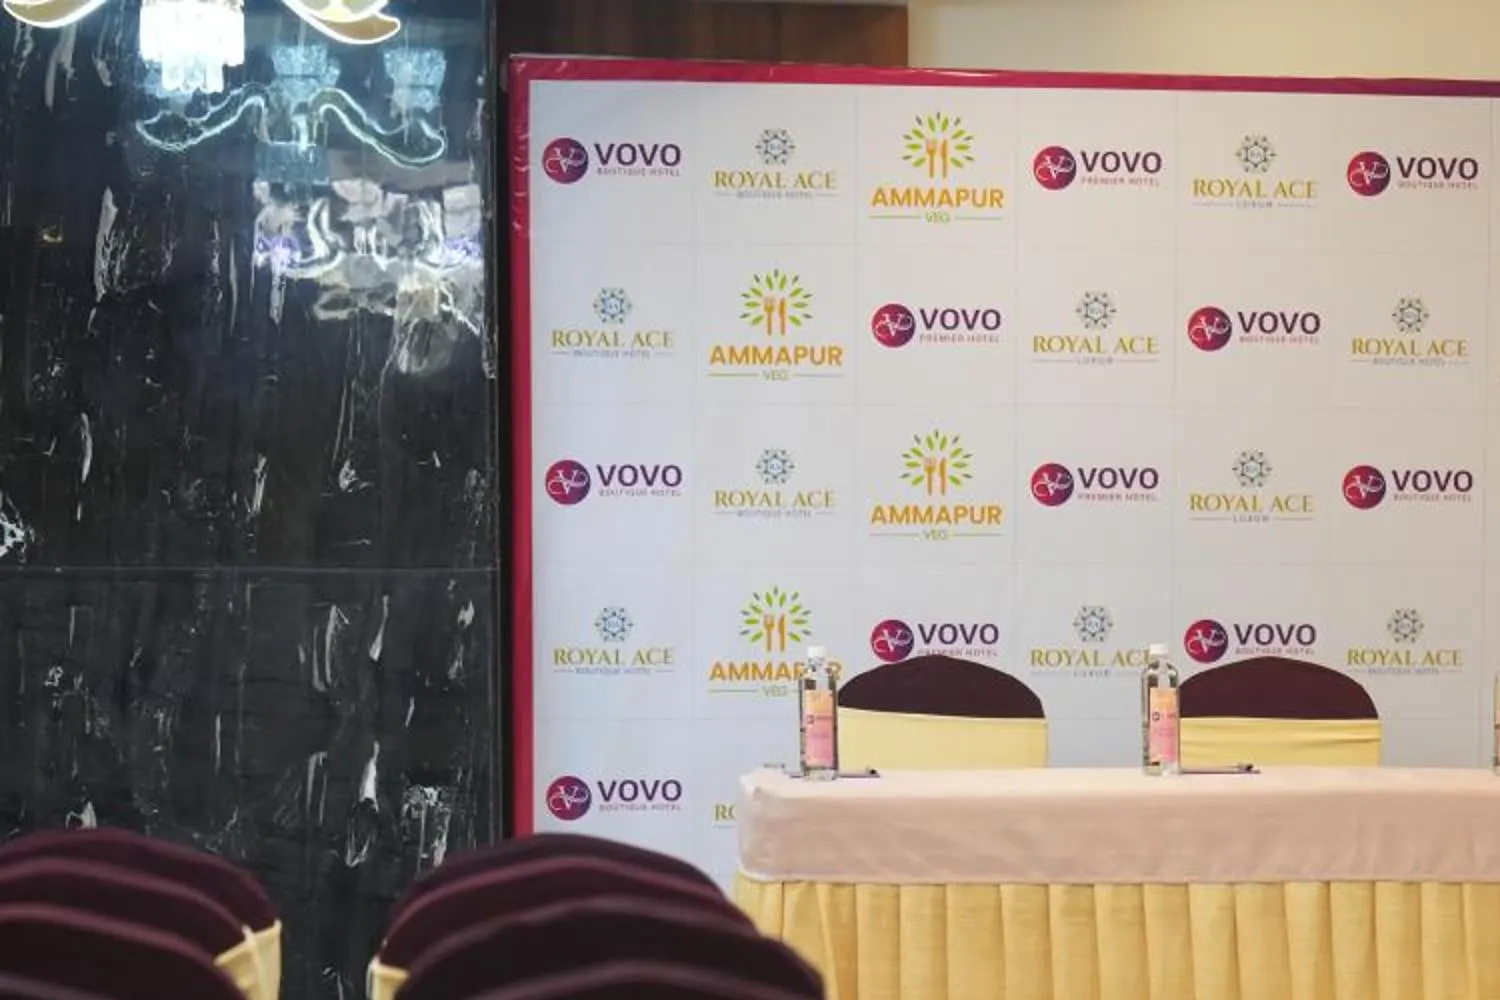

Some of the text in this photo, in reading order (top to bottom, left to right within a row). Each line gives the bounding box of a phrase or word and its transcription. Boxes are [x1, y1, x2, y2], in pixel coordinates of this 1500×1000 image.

[594, 143, 681, 167] VOVO
[1081, 151, 1162, 174] VOVO
[1396, 156, 1479, 180] VOVO
[714, 170, 836, 189] ROYAL ACE
[1193, 179, 1318, 199] ROYAL ACE
[871, 188, 1004, 208] AMMAPUR
[925, 211, 950, 224] VEG
[920, 309, 1000, 331] VOVO
[1238, 312, 1321, 335] VOVO
[551, 330, 674, 348] ROYAL ACE
[1032, 335, 1159, 354] ROYAL ACE
[1351, 338, 1469, 357] ROYAL ACE
[709, 346, 843, 366] AMMAPUR
[763, 370, 788, 382] VEG
[596, 465, 682, 487] VOVO
[1078, 467, 1159, 490] VOVO
[1392, 470, 1473, 493] VOVO
[714, 490, 834, 508] ROYAL ACE
[1190, 495, 1314, 513] ROYAL ACE
[870, 506, 1002, 526] AMMAPUR
[922, 528, 949, 540] VEG
[918, 624, 999, 646] VOVO
[1234, 624, 1316, 647] VOVO
[554, 648, 674, 665] ROYAL ACE
[1030, 649, 1104, 667] ROYAL
[1347, 649, 1463, 667] ROYAL ACE
[709, 662, 843, 682] AMMAPR
[762, 685, 788, 697] VEG
[597, 779, 682, 802] VOVO
